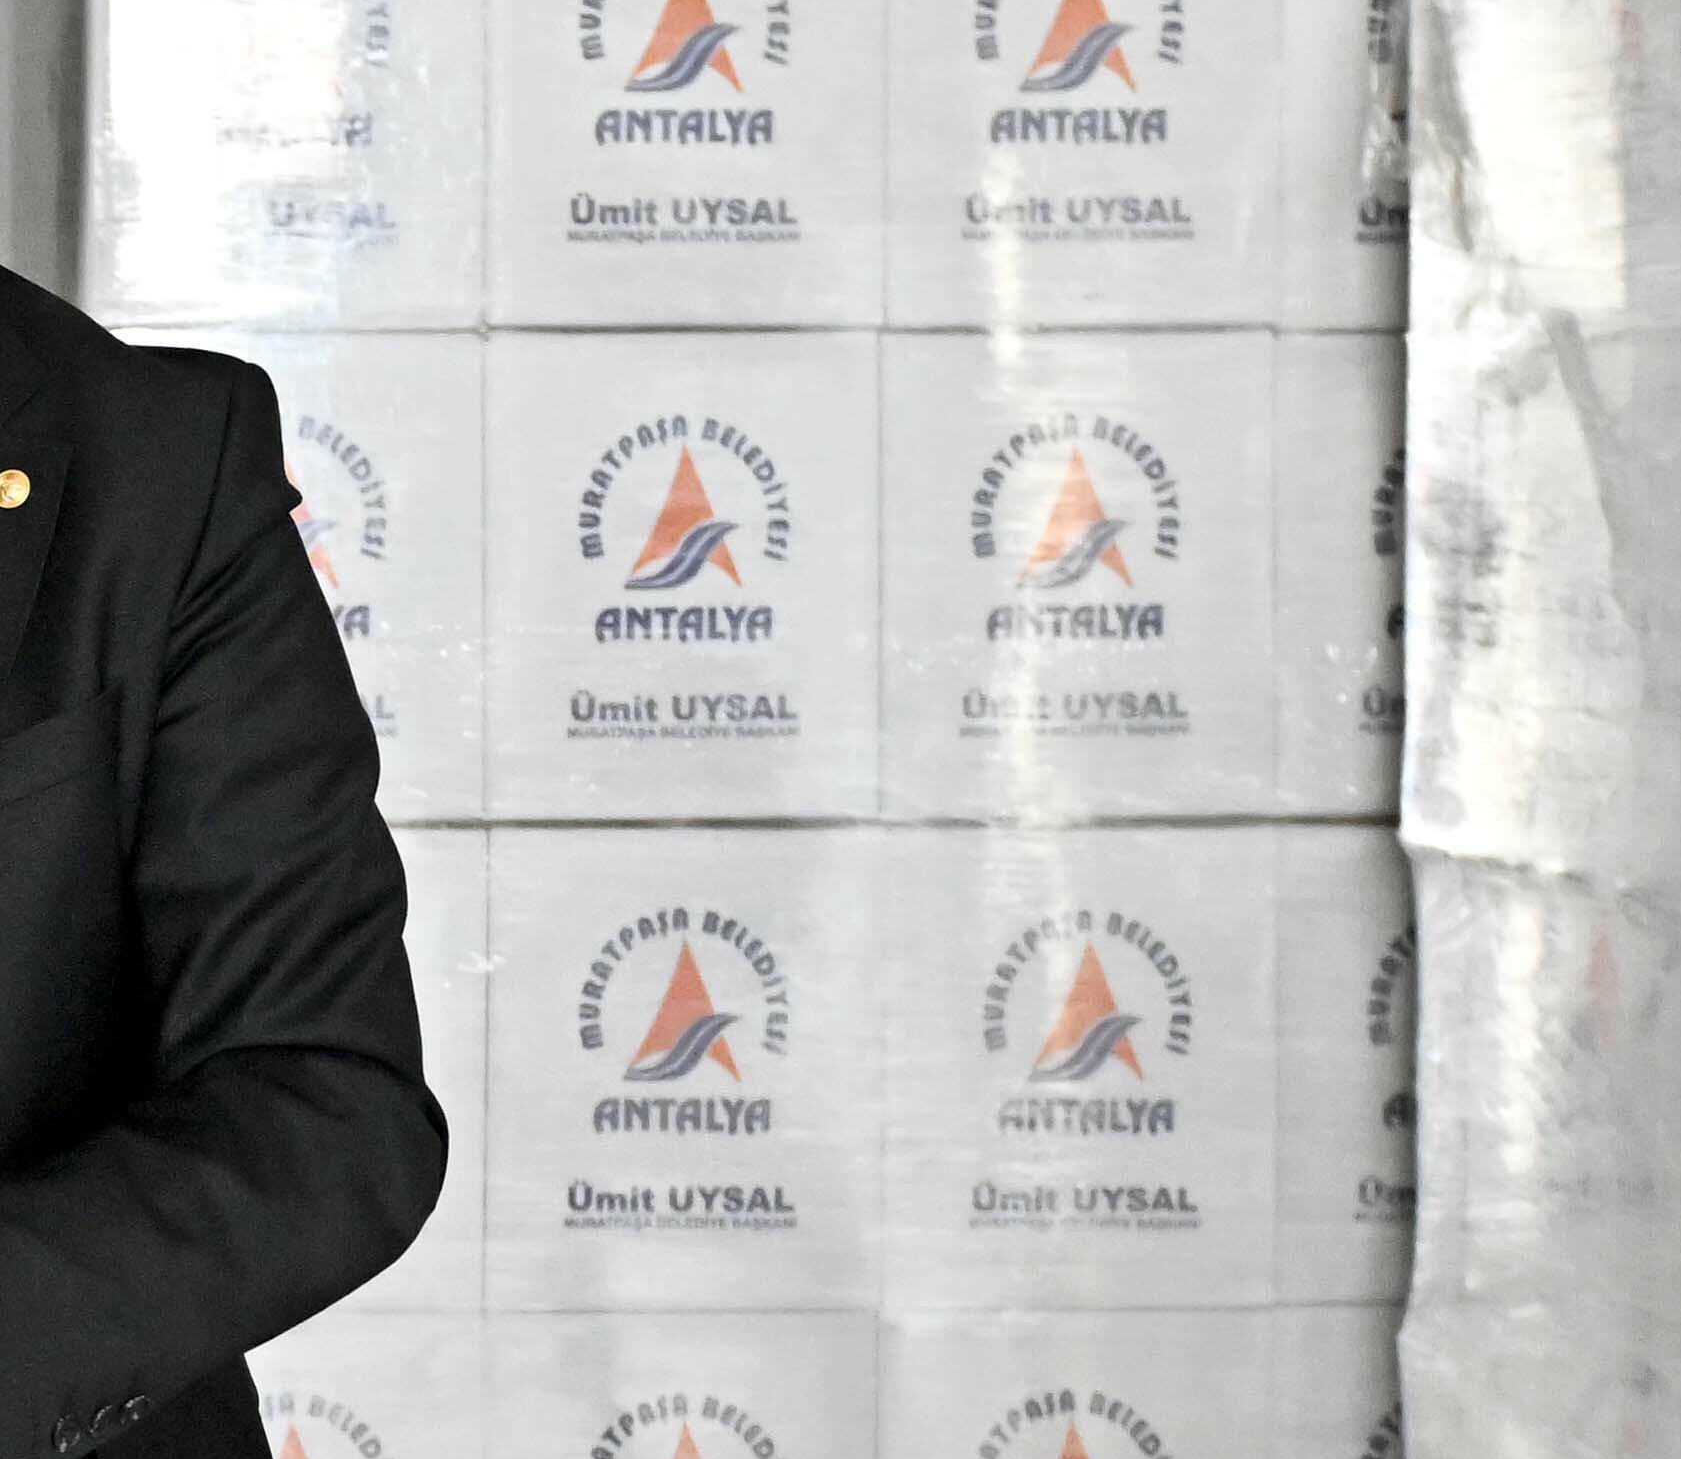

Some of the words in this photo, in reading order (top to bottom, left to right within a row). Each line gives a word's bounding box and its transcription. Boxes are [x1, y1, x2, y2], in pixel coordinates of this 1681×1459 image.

[595, 109, 773, 146] ANTALYA
[990, 107, 1167, 146] ANTALYA
[571, 192, 658, 225] Ümit
[673, 199, 797, 226] UYSAL
[1067, 197, 1191, 224] UYSAL
[595, 605, 773, 644] ANTALYA
[571, 689, 658, 722] Ümit
[673, 694, 797, 722] UYSAL
[594, 1097, 771, 1135] ANTALYA
[568, 1180, 655, 1212] Ümit
[670, 1187, 794, 1213] UYSAL
